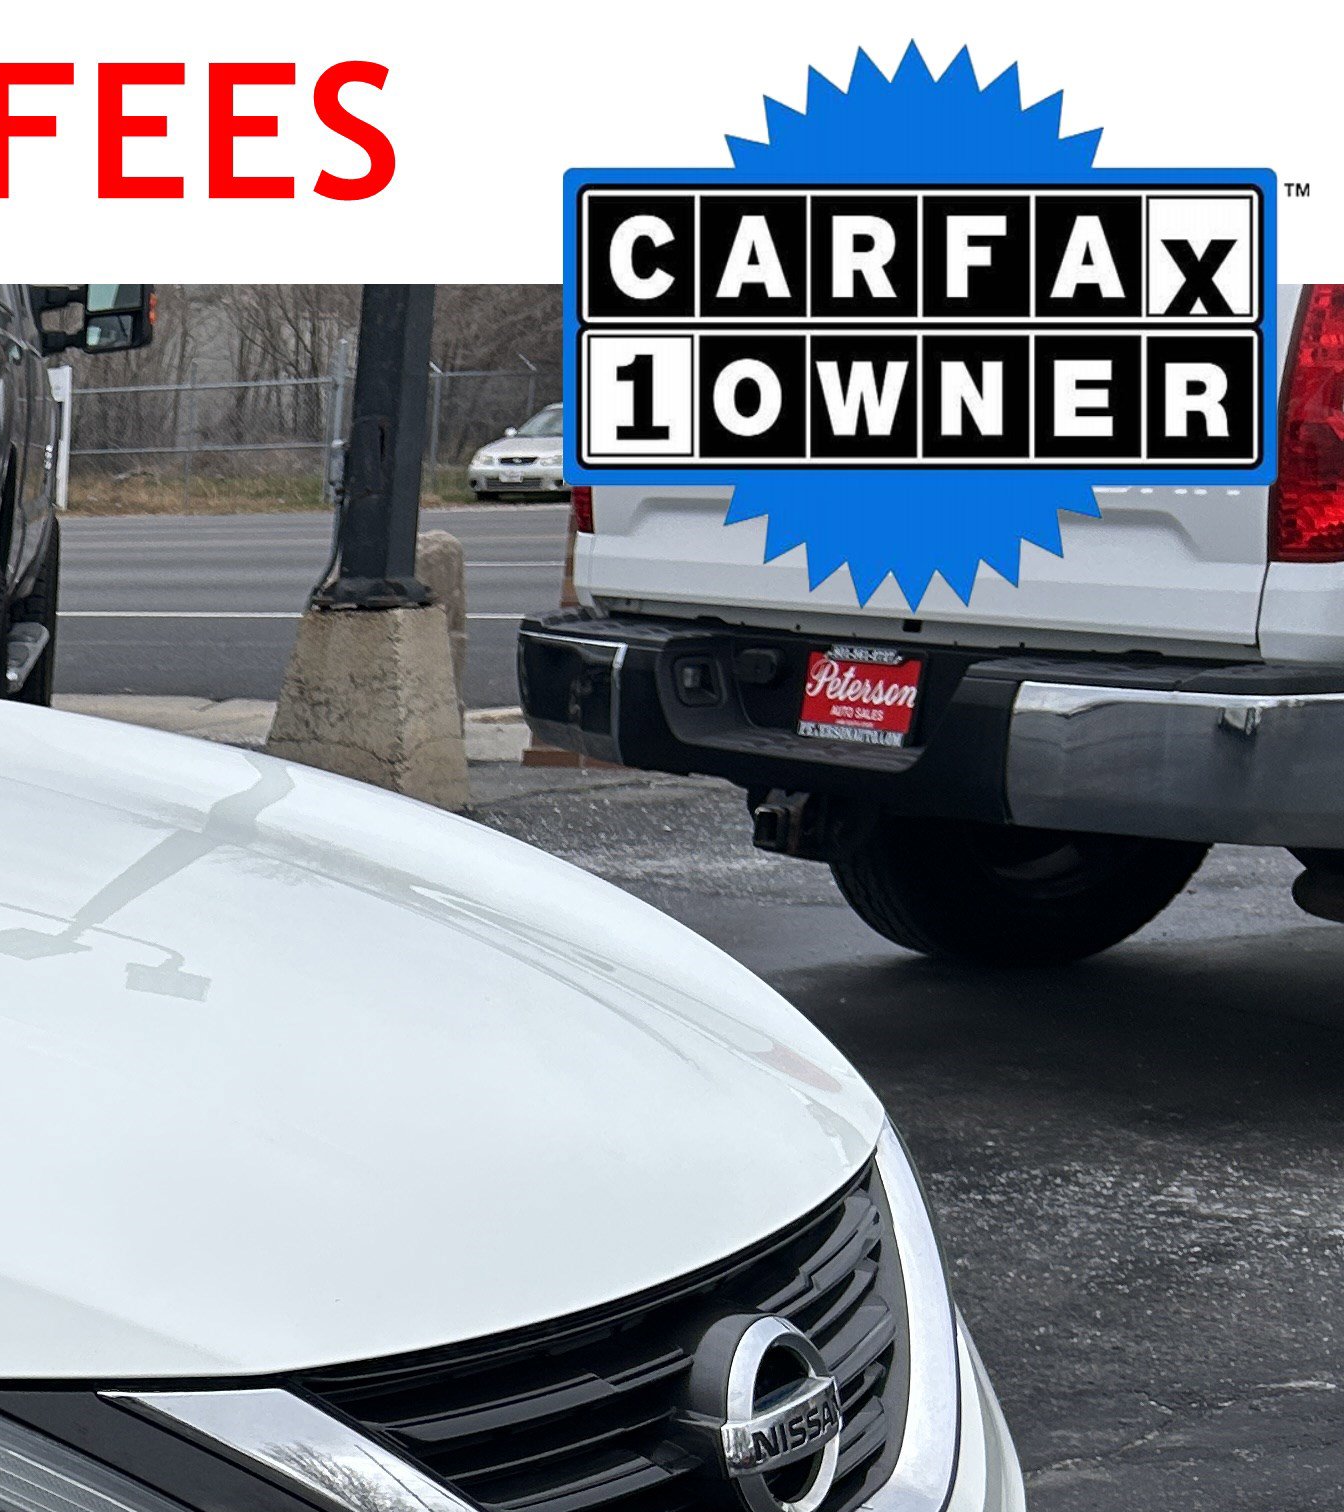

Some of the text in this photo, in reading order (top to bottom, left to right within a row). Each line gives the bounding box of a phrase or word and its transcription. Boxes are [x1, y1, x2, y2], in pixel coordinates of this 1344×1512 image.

[805, 659, 918, 709] Peterson
[830, 705, 884, 721] AUTO SALES
